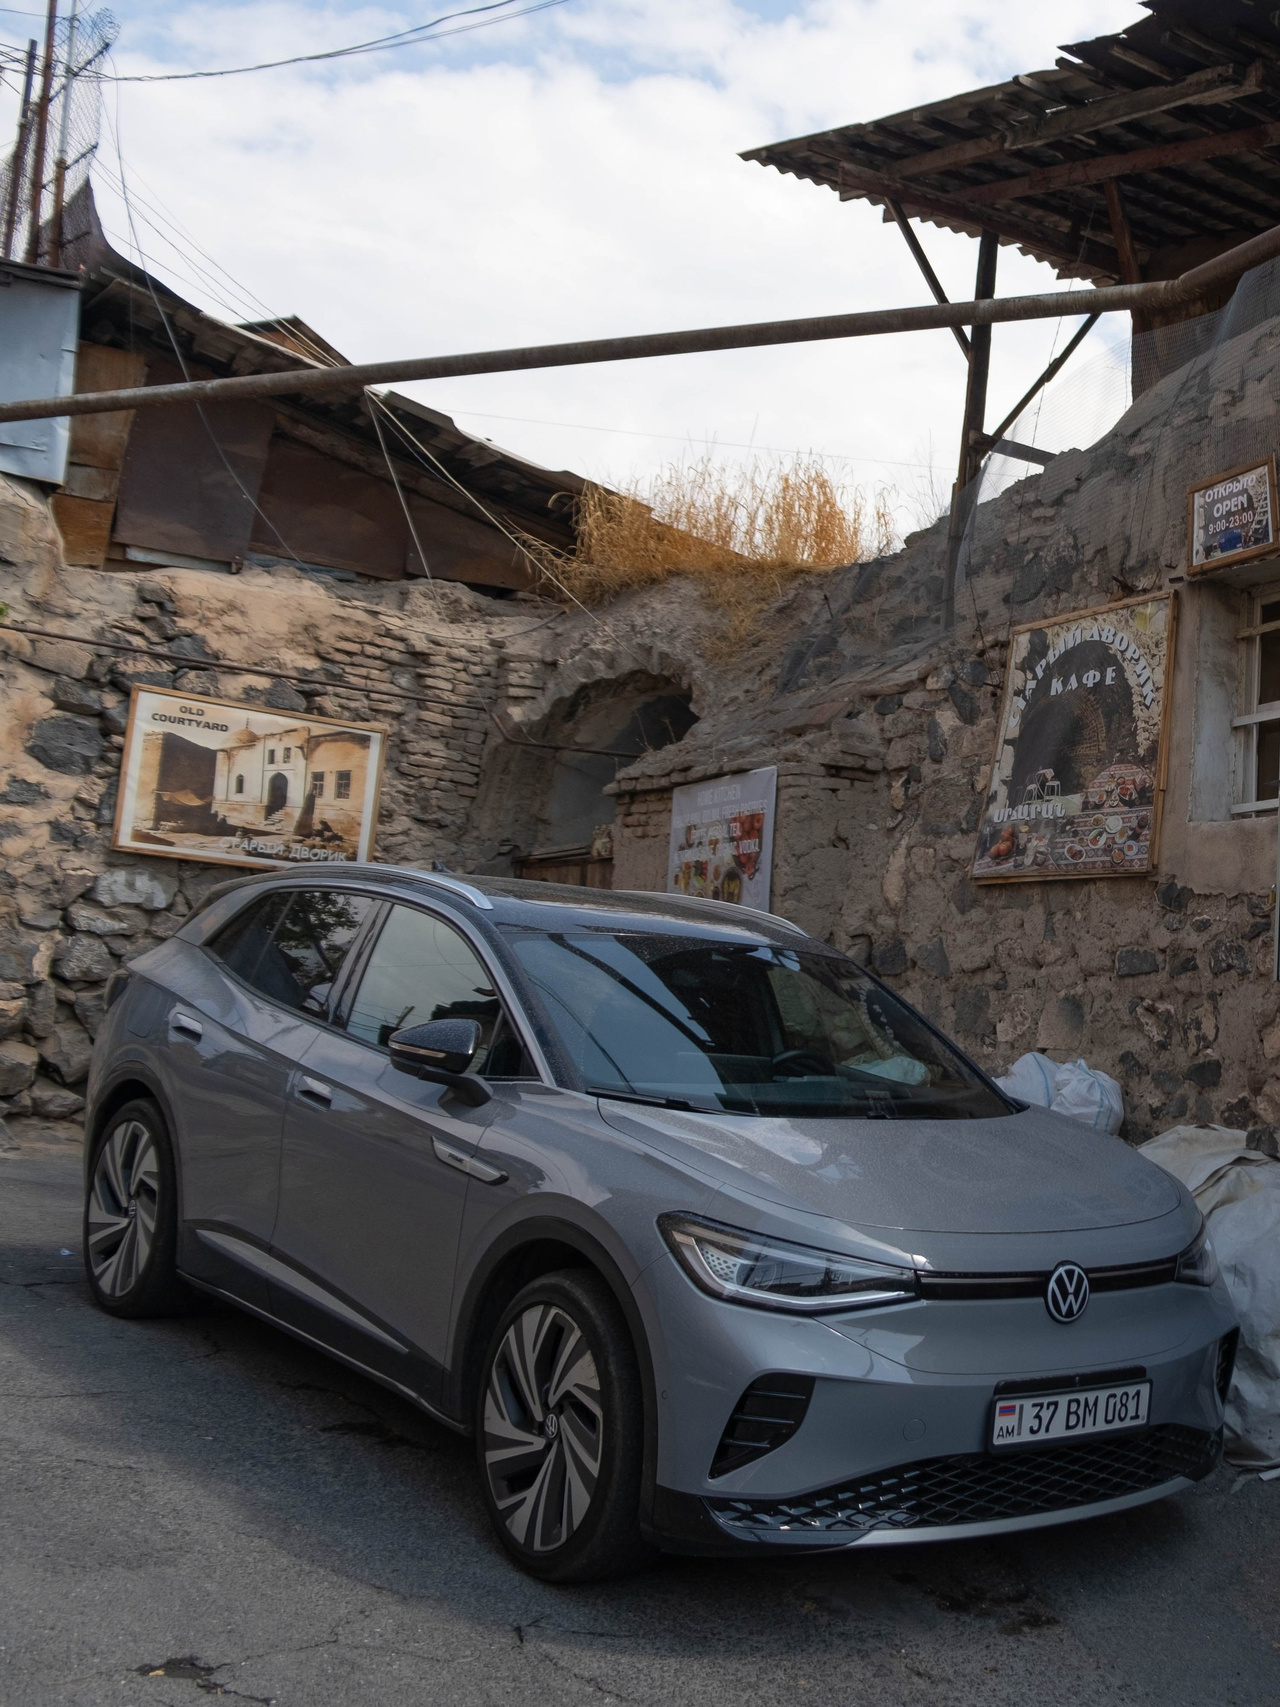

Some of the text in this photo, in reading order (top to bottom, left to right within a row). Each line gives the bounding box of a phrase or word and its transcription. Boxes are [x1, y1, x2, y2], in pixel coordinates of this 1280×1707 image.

[1205, 474, 1256, 502] ОТКРЫТО
[1213, 494, 1248, 518] OPEN
[1208, 510, 1254, 535] 9:00-23:00
[1008, 624, 1156, 728] СТАРЫЙ ДВОРИК
[1050, 666, 1117, 696] КАФЕ
[151, 712, 229, 733] COURTYARD
[179, 705, 205, 717] OLD
[289, 845, 348, 862] ДВОРИК
[996, 1389, 1141, 1439] AM 37 BM 081
